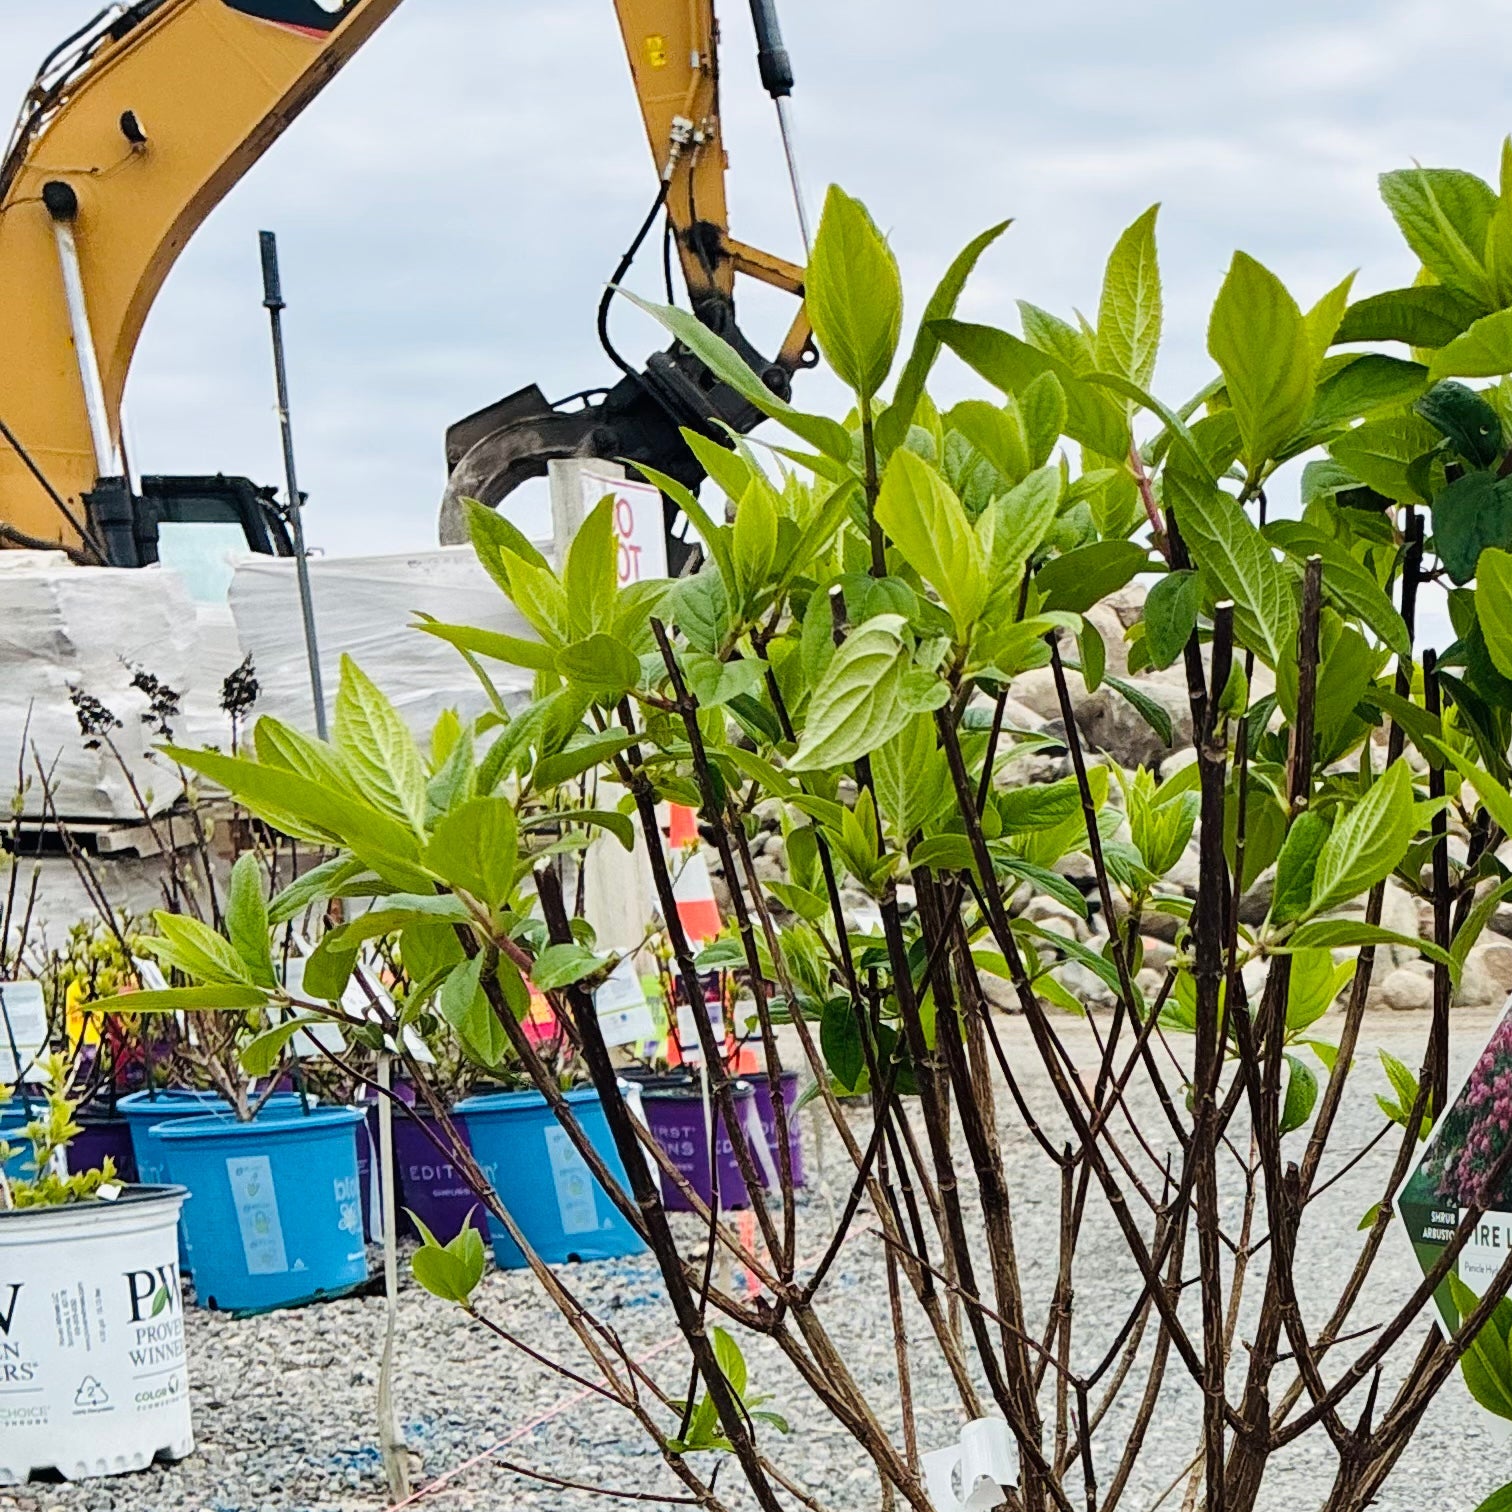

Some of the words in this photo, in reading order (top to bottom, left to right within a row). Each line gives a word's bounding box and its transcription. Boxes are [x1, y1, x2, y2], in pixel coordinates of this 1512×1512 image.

[615, 498, 634, 538] O
[410, 1164, 455, 1181] EDIT
[1431, 1210, 1456, 1225] SHRUB
[1474, 1224, 1501, 1248] IRE
[136, 1318, 182, 1346] PROVE
[129, 1338, 184, 1367] WINNE
